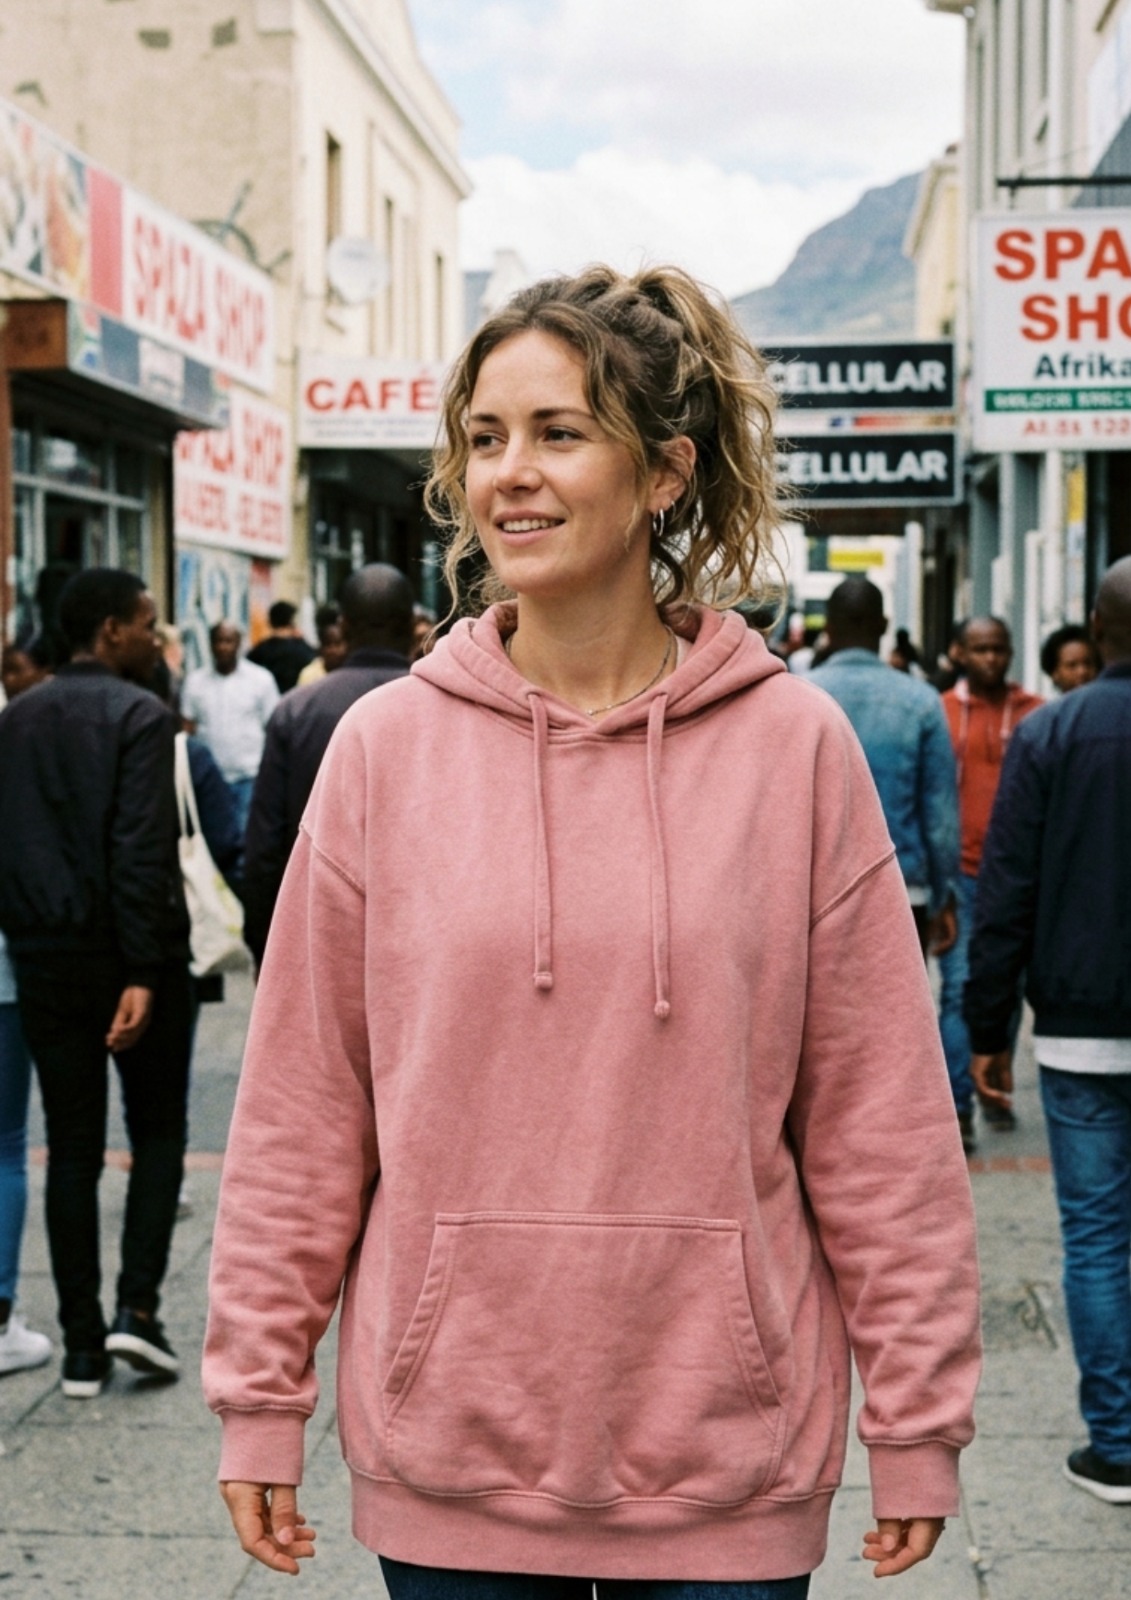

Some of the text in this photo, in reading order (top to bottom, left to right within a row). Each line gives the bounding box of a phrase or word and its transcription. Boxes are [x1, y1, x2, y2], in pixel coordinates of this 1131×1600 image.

[994, 228, 1131, 281] SPA
[133, 214, 266, 373] SPAZA SHOP
[304, 367, 439, 412] CAFÉ
[766, 360, 947, 394] CELLULAR
[241, 407, 284, 489] SHOP
[773, 450, 947, 484] CELLULAR
